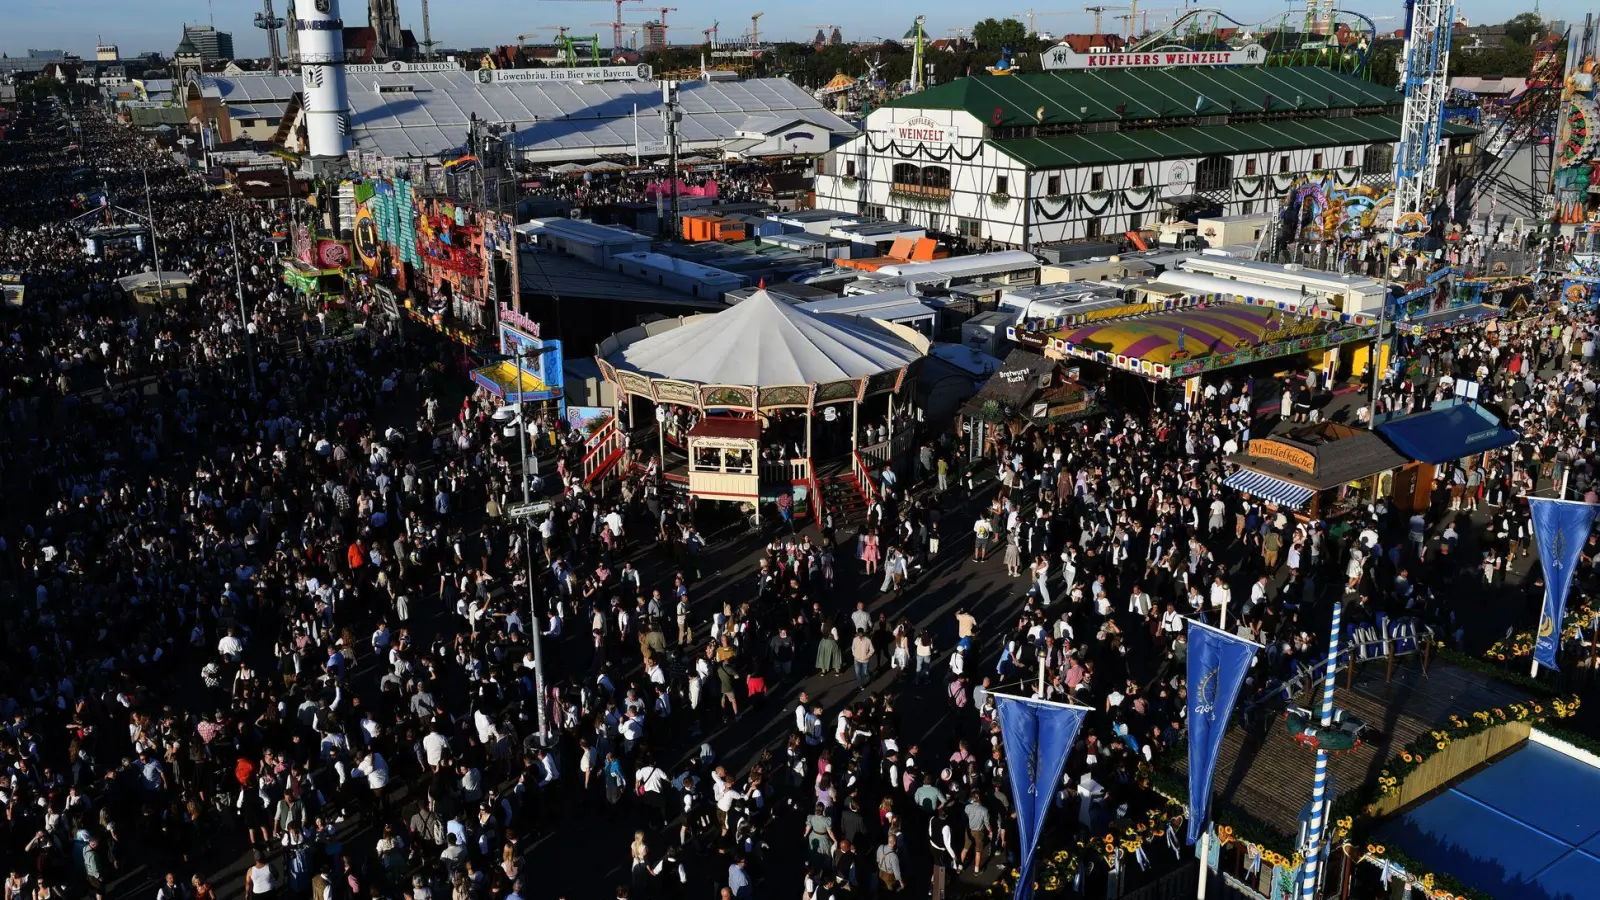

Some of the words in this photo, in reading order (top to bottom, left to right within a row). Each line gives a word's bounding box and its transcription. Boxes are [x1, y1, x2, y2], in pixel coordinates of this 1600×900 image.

[1088, 54, 1159, 66] KUFFLERS
[1165, 53, 1231, 65] WEINZELT
[497, 71, 548, 80] Löwenbräu.
[550, 70, 565, 79] Ein
[567, 70, 585, 79] Bier
[586, 69, 601, 78] wie
[603, 69, 634, 79] Bayern.
[908, 117, 935, 129] KUFFLERS
[899, 128, 944, 141] WEINZELT
[999, 367, 1030, 378] Bratwurst
[1250, 442, 1313, 469] Mandelküche
